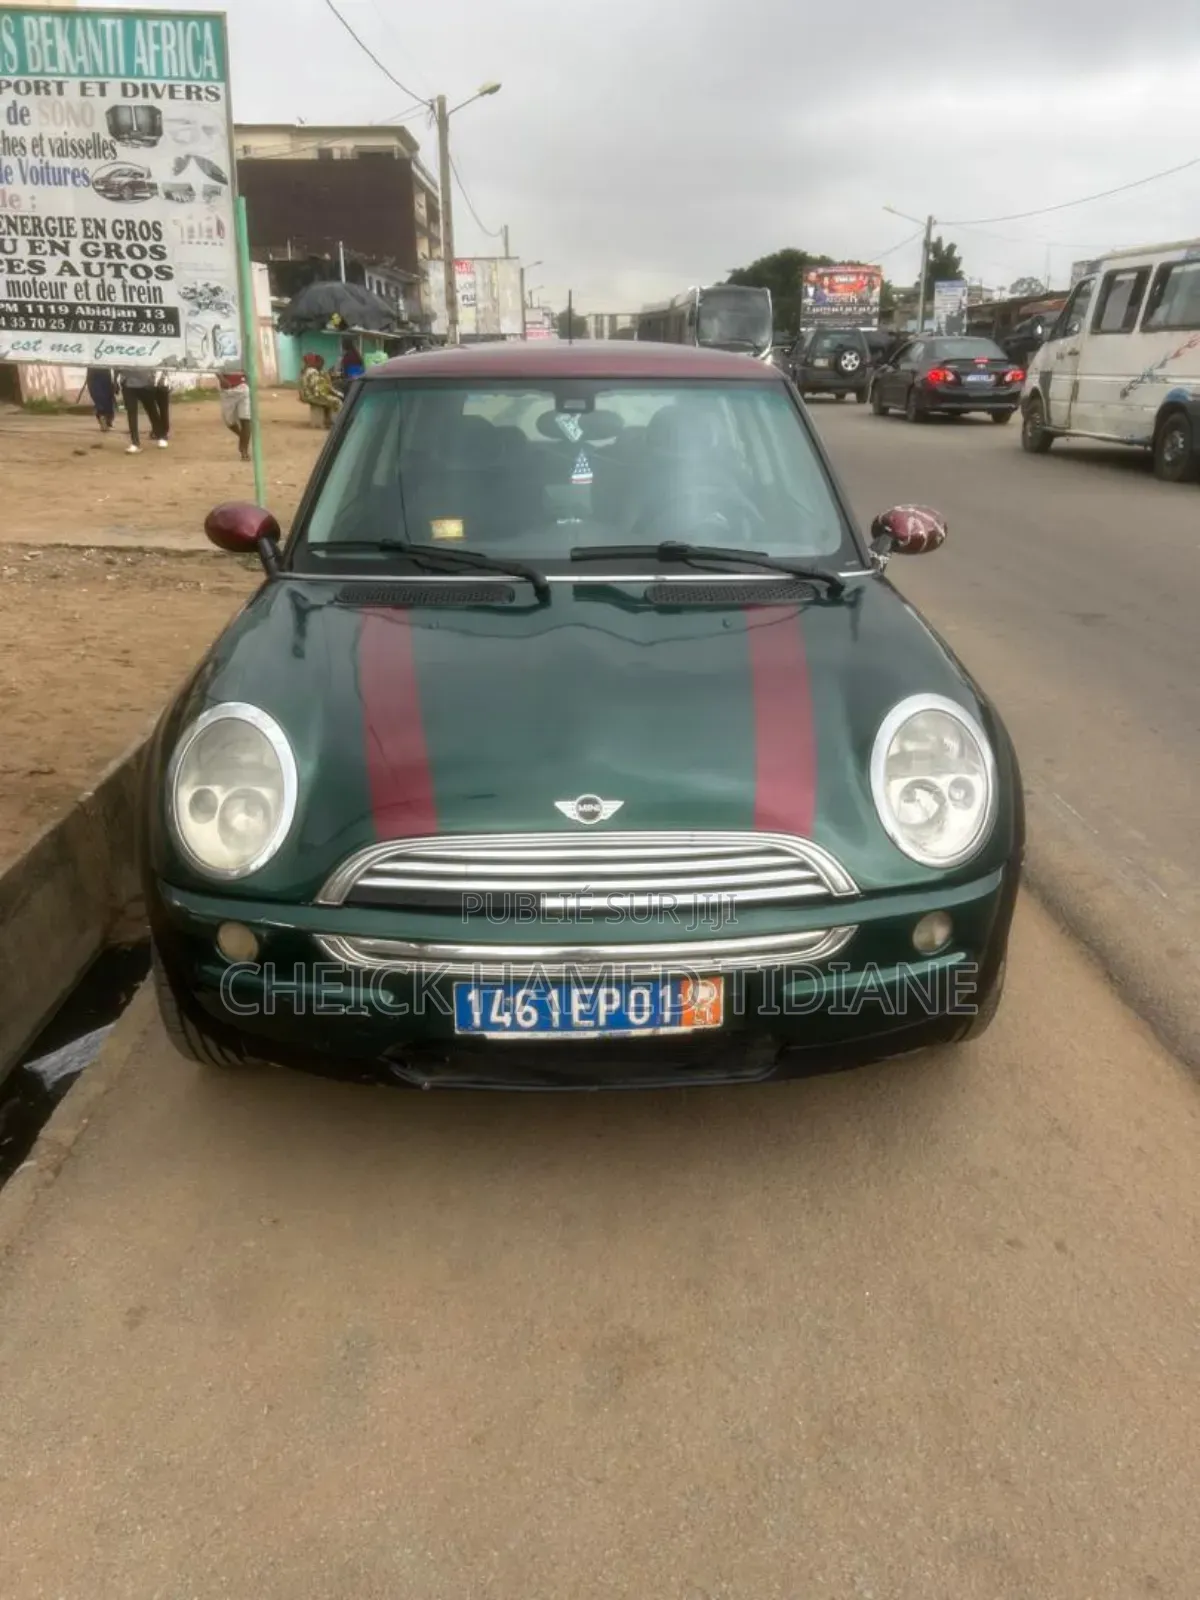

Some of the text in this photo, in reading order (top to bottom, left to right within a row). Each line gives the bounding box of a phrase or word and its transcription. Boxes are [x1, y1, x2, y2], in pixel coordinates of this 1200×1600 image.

[23, 15, 126, 76] BEKANTI
[134, 20, 219, 79] AFRICA
[80, 81, 110, 97] ET
[121, 82, 221, 101] DIVERS
[6, 100, 95, 129] de SONO
[0, 130, 118, 161] hes et vaisselles
[17, 158, 92, 188] Voitures
[81, 218, 107, 239] EN
[111, 219, 163, 242] GROS
[26, 239, 71, 256] EN
[80, 241, 167, 261] GROS
[56, 260, 174, 281] AUTOS
[6, 277, 164, 305] moteur et de frein
[25, 303, 70, 315] 1119
[75, 306, 137, 320] Abidjan
[144, 308, 166, 320] 13
[29, 317, 46, 330] 70
[49, 318, 66, 331] 25
[78, 319, 95, 332] 07
[100, 321, 114, 332] 57
[118, 321, 134, 333] 37
[138, 322, 155, 335] 20
[158, 323, 175, 336] 39
[50, 343, 85, 354] ma
[94, 340, 160, 360] force!
[467, 983, 675, 1028] 1461EP01
